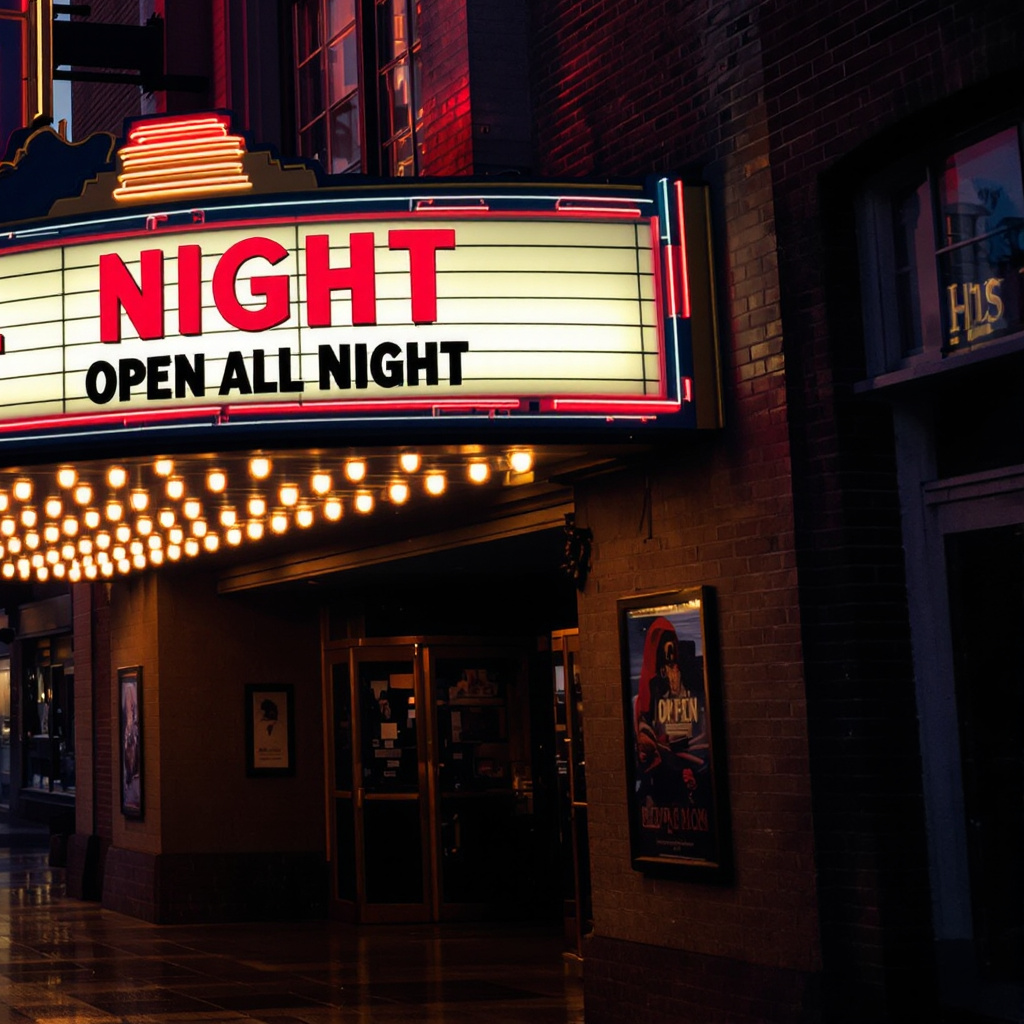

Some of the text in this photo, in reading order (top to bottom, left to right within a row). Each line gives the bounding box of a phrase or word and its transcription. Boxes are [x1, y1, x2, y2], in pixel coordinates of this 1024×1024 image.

[99, 229, 456, 343] NIGHT
[85, 341, 469, 404] OPEN ALL NIGHT
